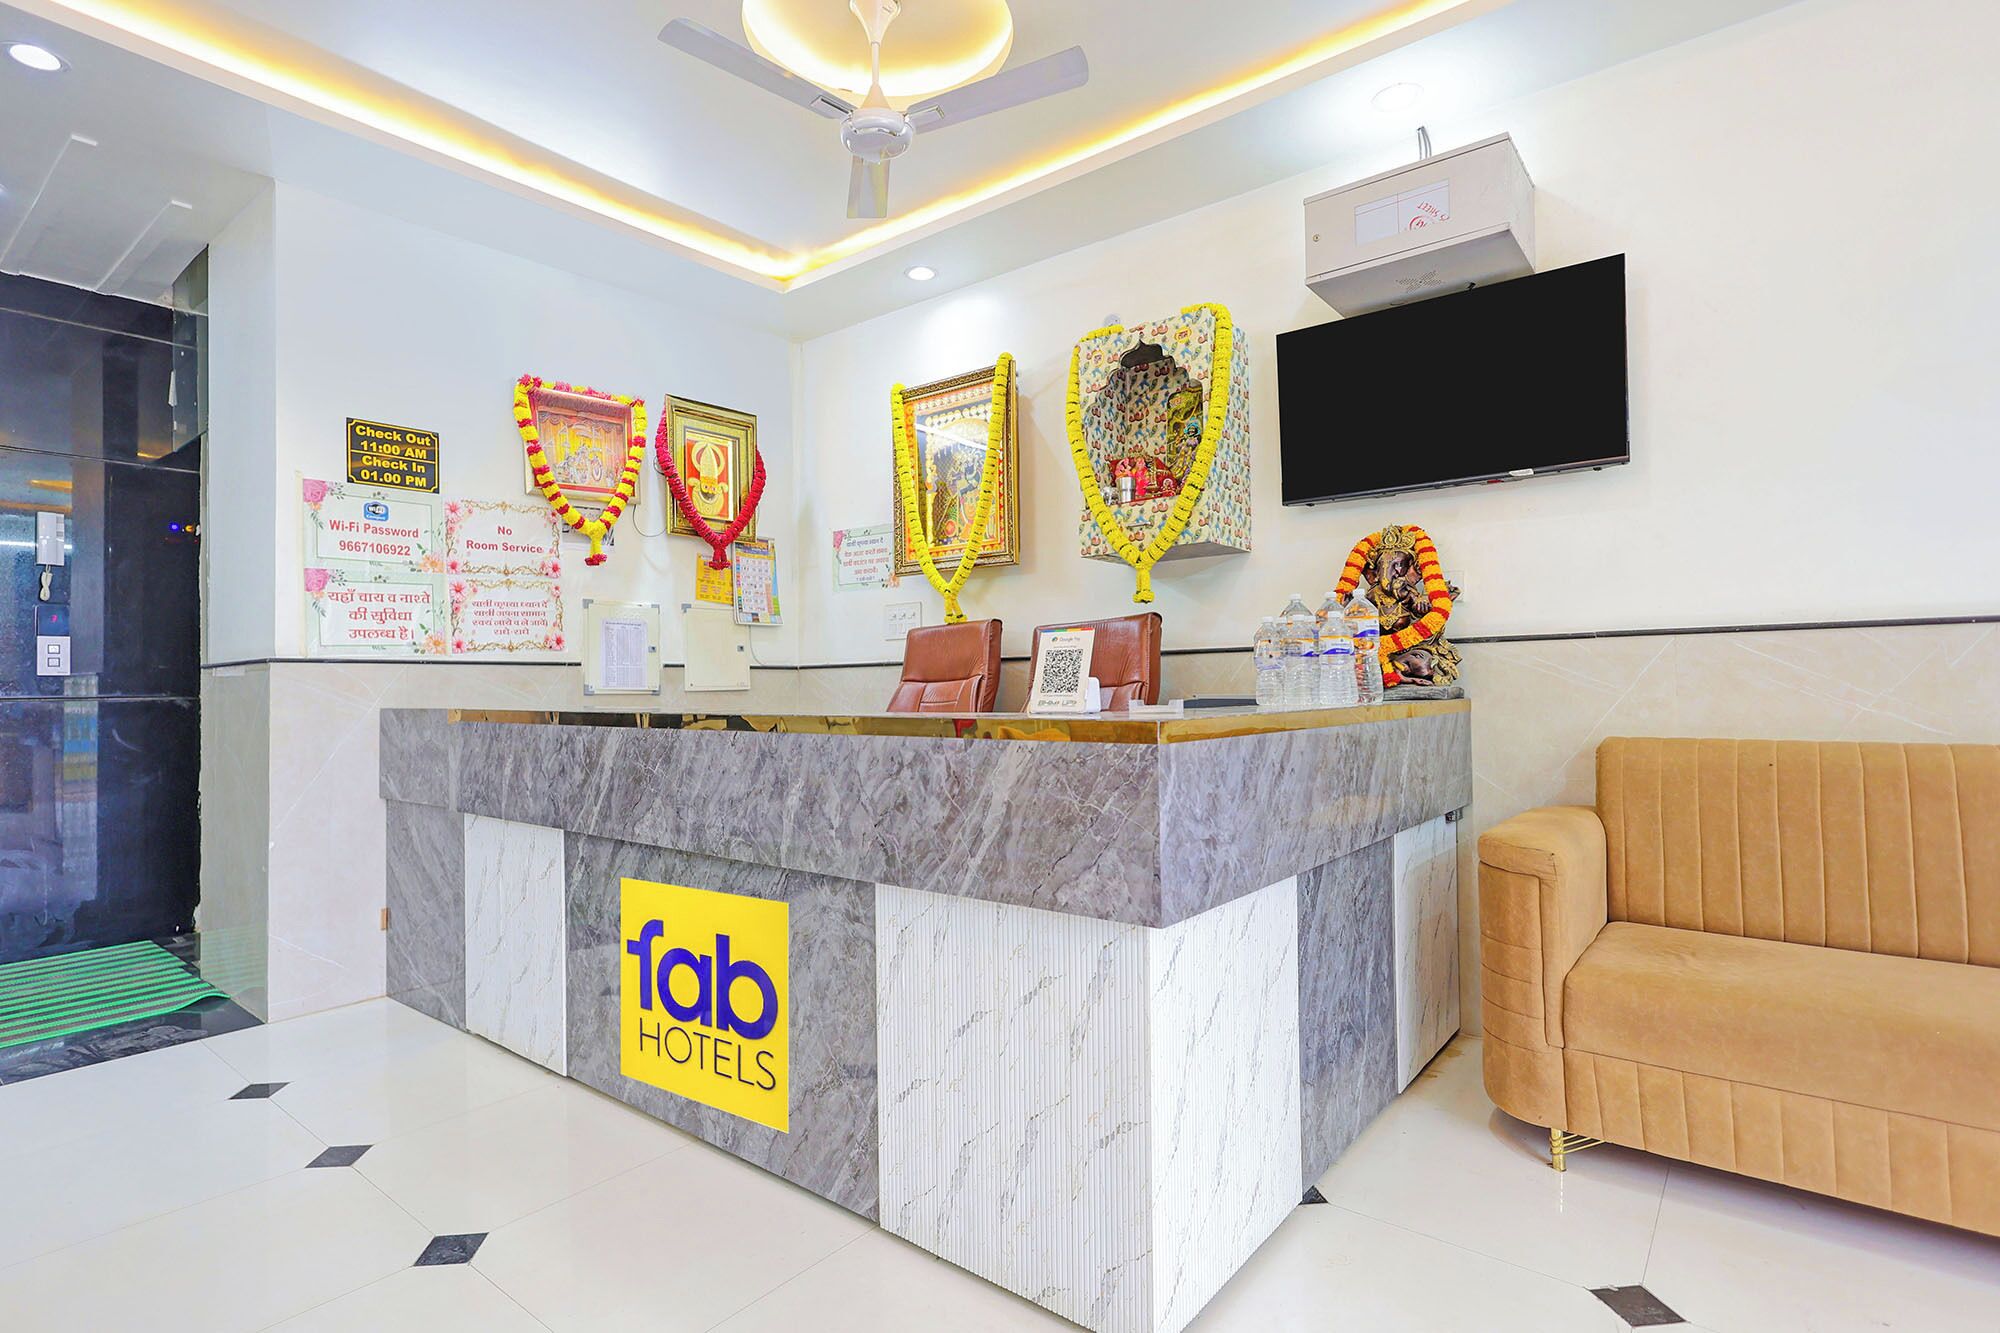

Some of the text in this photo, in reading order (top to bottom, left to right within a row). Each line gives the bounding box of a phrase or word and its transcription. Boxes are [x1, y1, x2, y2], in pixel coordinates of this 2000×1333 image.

[355, 425, 431, 446] Check Out
[360, 440, 427, 459] 11:00 AM
[361, 455, 426, 473] Check In
[360, 469, 427, 487] 01.00 PM
[329, 519, 419, 538] Wi-Fi Password
[497, 526, 513, 536] No
[339, 540, 411, 556] 9667106922
[466, 540, 544, 554] Room Service
[348, 607, 412, 624] की सुविधा
[626, 919, 779, 1040] fab
[639, 1017, 776, 1091] HOTELS
